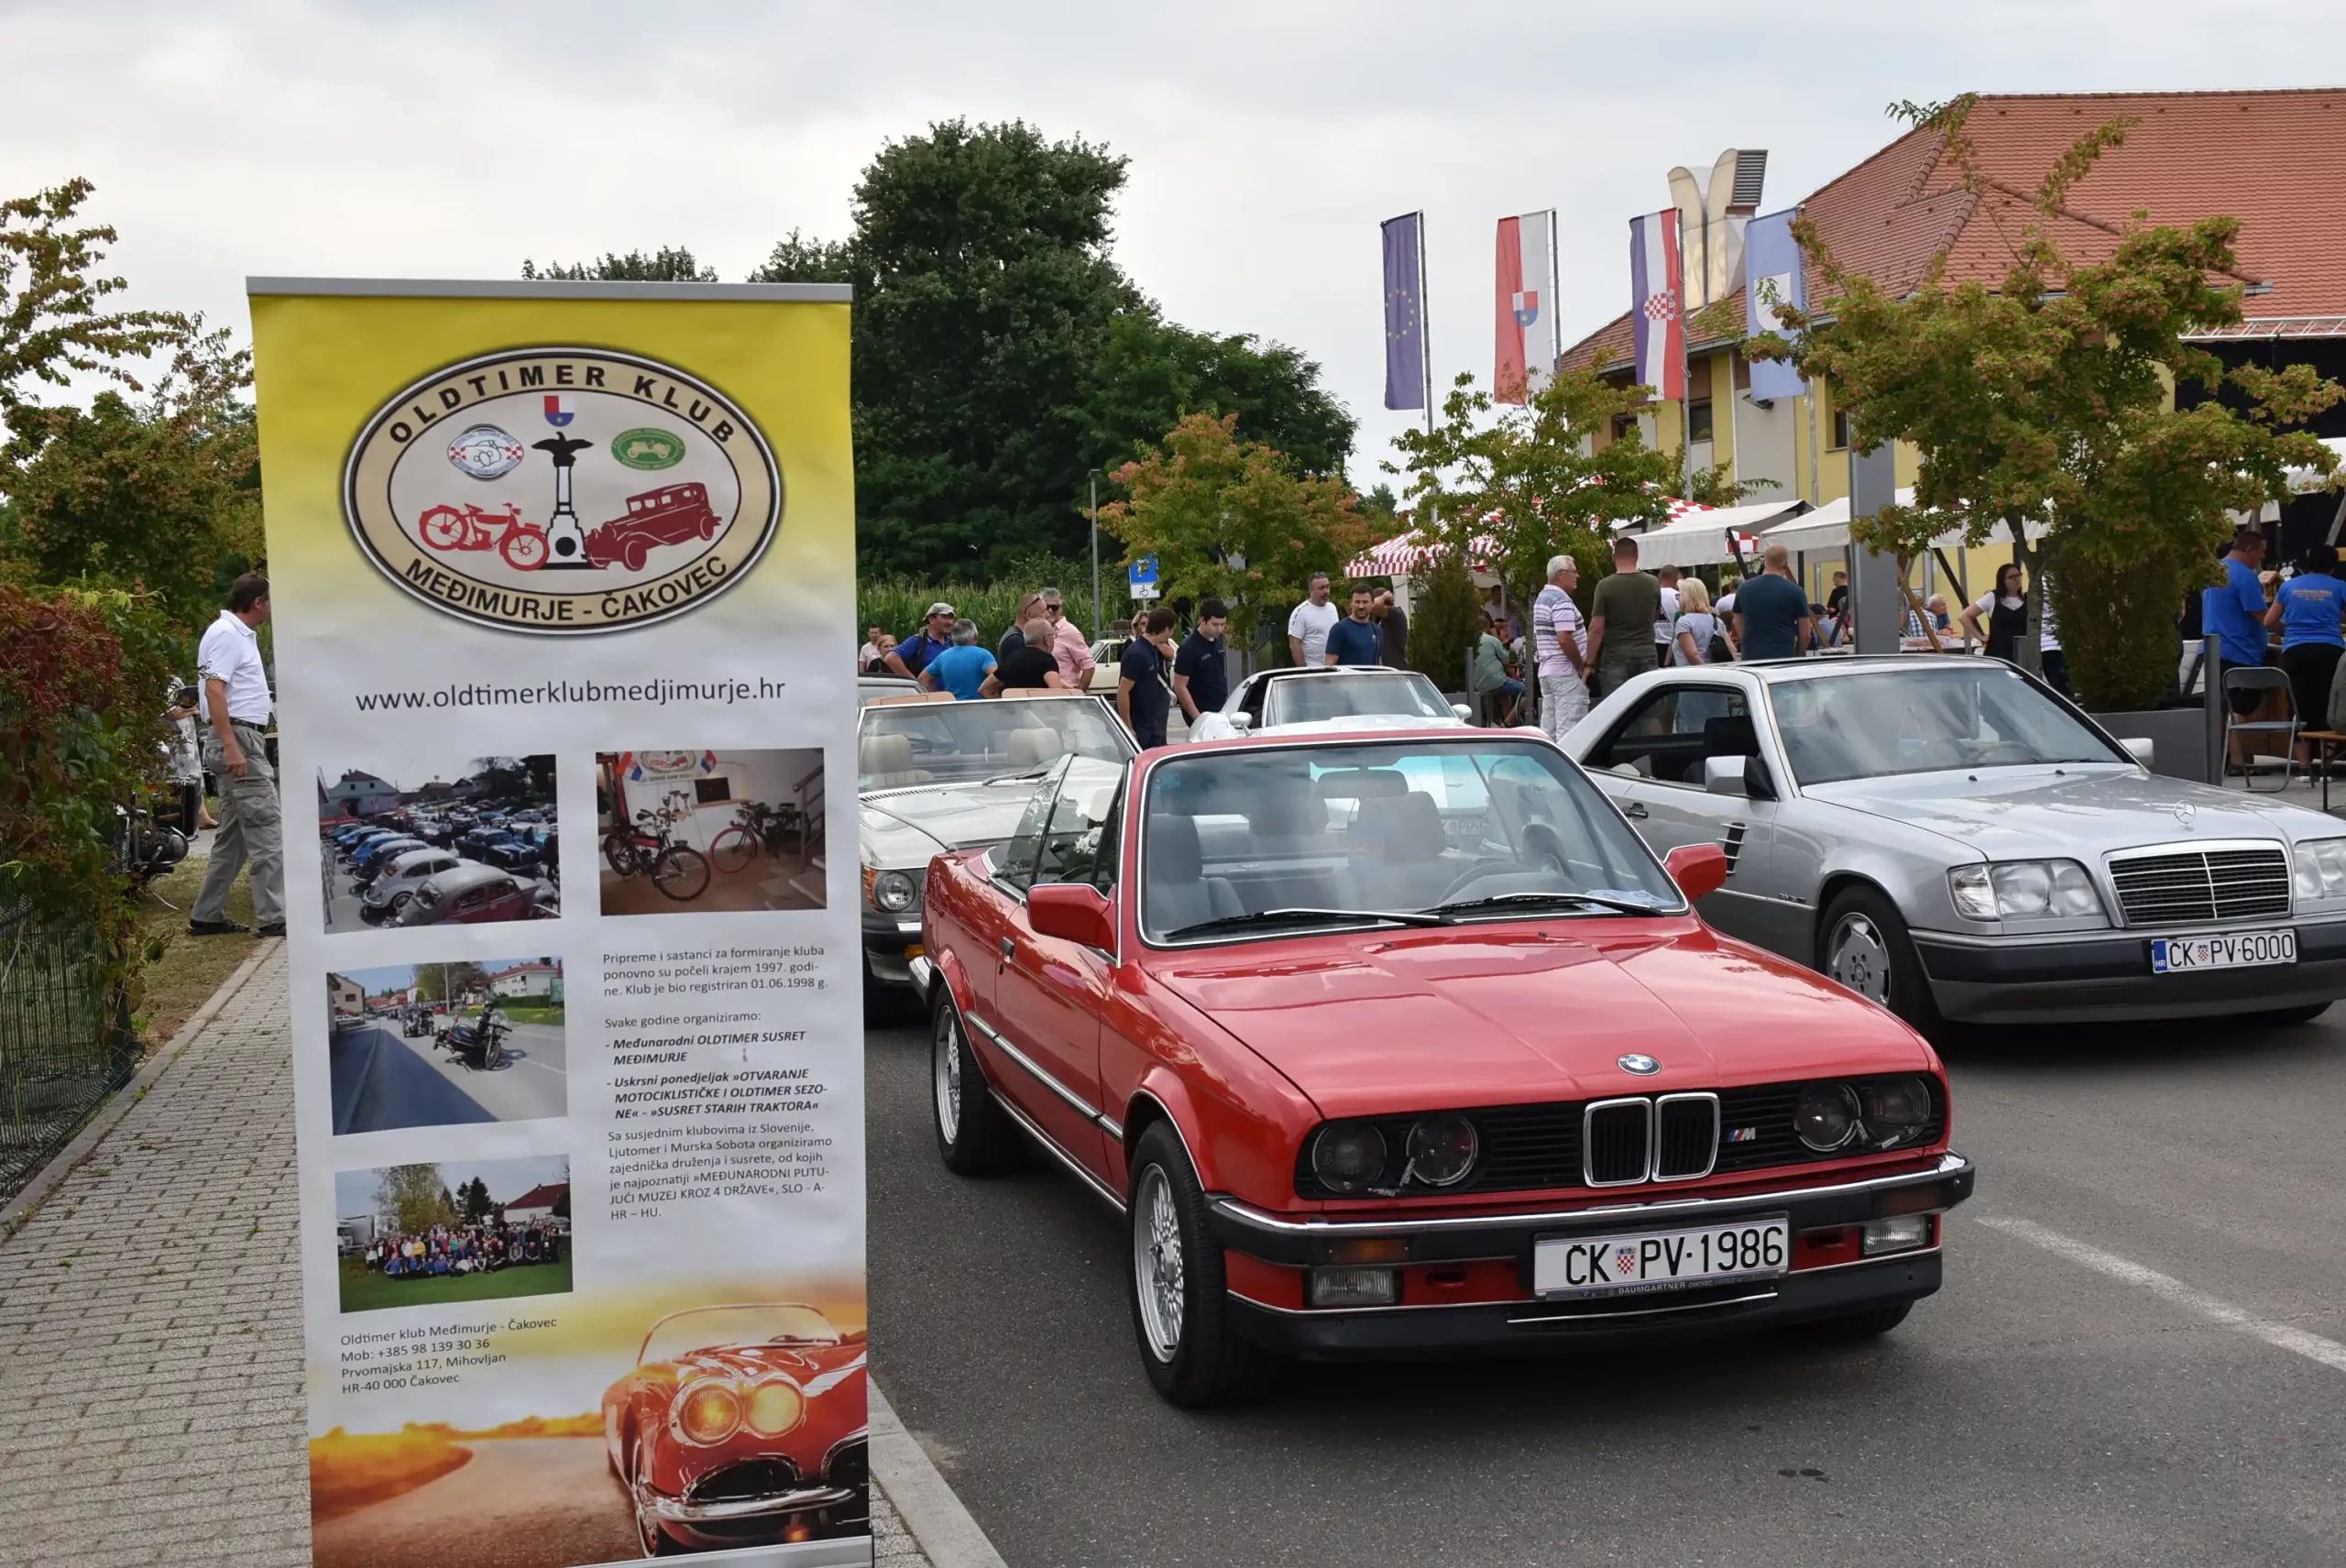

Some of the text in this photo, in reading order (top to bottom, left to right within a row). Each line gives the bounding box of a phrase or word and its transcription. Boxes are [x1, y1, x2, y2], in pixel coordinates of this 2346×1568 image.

[389, 364, 735, 444] OLDTIMER KLUB
[404, 557, 575, 622] MEĐIMURJE
[600, 555, 727, 619] ČAKOVEC
[356, 677, 784, 710] www.oldtimerklubmedjimurje.hr
[603, 953, 656, 965] Pripreme
[667, 949, 711, 960] sastanci
[731, 947, 790, 959] formiranje
[794, 946, 824, 956] kluba
[2169, 942, 2196, 967] ČK
[604, 970, 655, 981] ponovno
[674, 965, 708, 978] počeli
[712, 964, 751, 975] krajem
[755, 962, 785, 972] 1997.
[790, 961, 817, 973] godi-
[604, 978, 828, 996] ne. Klub je bio registriran 01.06.1998 g.
[605, 1013, 761, 1028] Svake godine organiziramo:
[613, 1036, 694, 1048] Međunarodni
[697, 1034, 759, 1045] OLDTIMER
[762, 1031, 806, 1042] SUSRET
[613, 1052, 687, 1065] MEĐIMURJE
[615, 1075, 658, 1087] Uskrsni
[661, 1072, 729, 1086] ponedjeljak
[615, 1084, 827, 1103] MOTOCIKLISTIČKE I OLDTIMER SEZO-
[705, 1103, 746, 1113] STARIH
[608, 1123, 813, 1141] Sa susjednim klubovima iz Slovenije,
[609, 1137, 832, 1159] Ljutomer i Murska Sobota organiziramo
[609, 1152, 822, 1175] zajednička druženja i susrete, od kojih
[609, 1182, 620, 1191] je
[624, 1174, 688, 1190] najpoznatiji
[794, 1167, 828, 1177] PUTU-
[610, 1191, 634, 1204] JUĆI
[639, 1190, 676, 1202] MUZEJ
[681, 1188, 710, 1199] KROZ
[713, 1187, 720, 1195] 4
[782, 1184, 803, 1193] SLO
[814, 1182, 824, 1191] A-
[611, 1210, 627, 1220] HR
[641, 1208, 661, 1217] HU.
[1566, 1244, 1611, 1285] ČK
[1618, 1281, 1686, 1295] BAUMGARTNER
[341, 1333, 396, 1345] Oldtimer
[400, 1328, 425, 1339] klub
[430, 1322, 497, 1336] Međimurje
[508, 1318, 557, 1330] Čakovec
[341, 1338, 490, 1362] Mob: +385 98 139 30 36
[342, 1353, 506, 1377] Prvomajska 117, Mihovljan
[343, 1374, 459, 1394] HR-40 000 Čakovec
